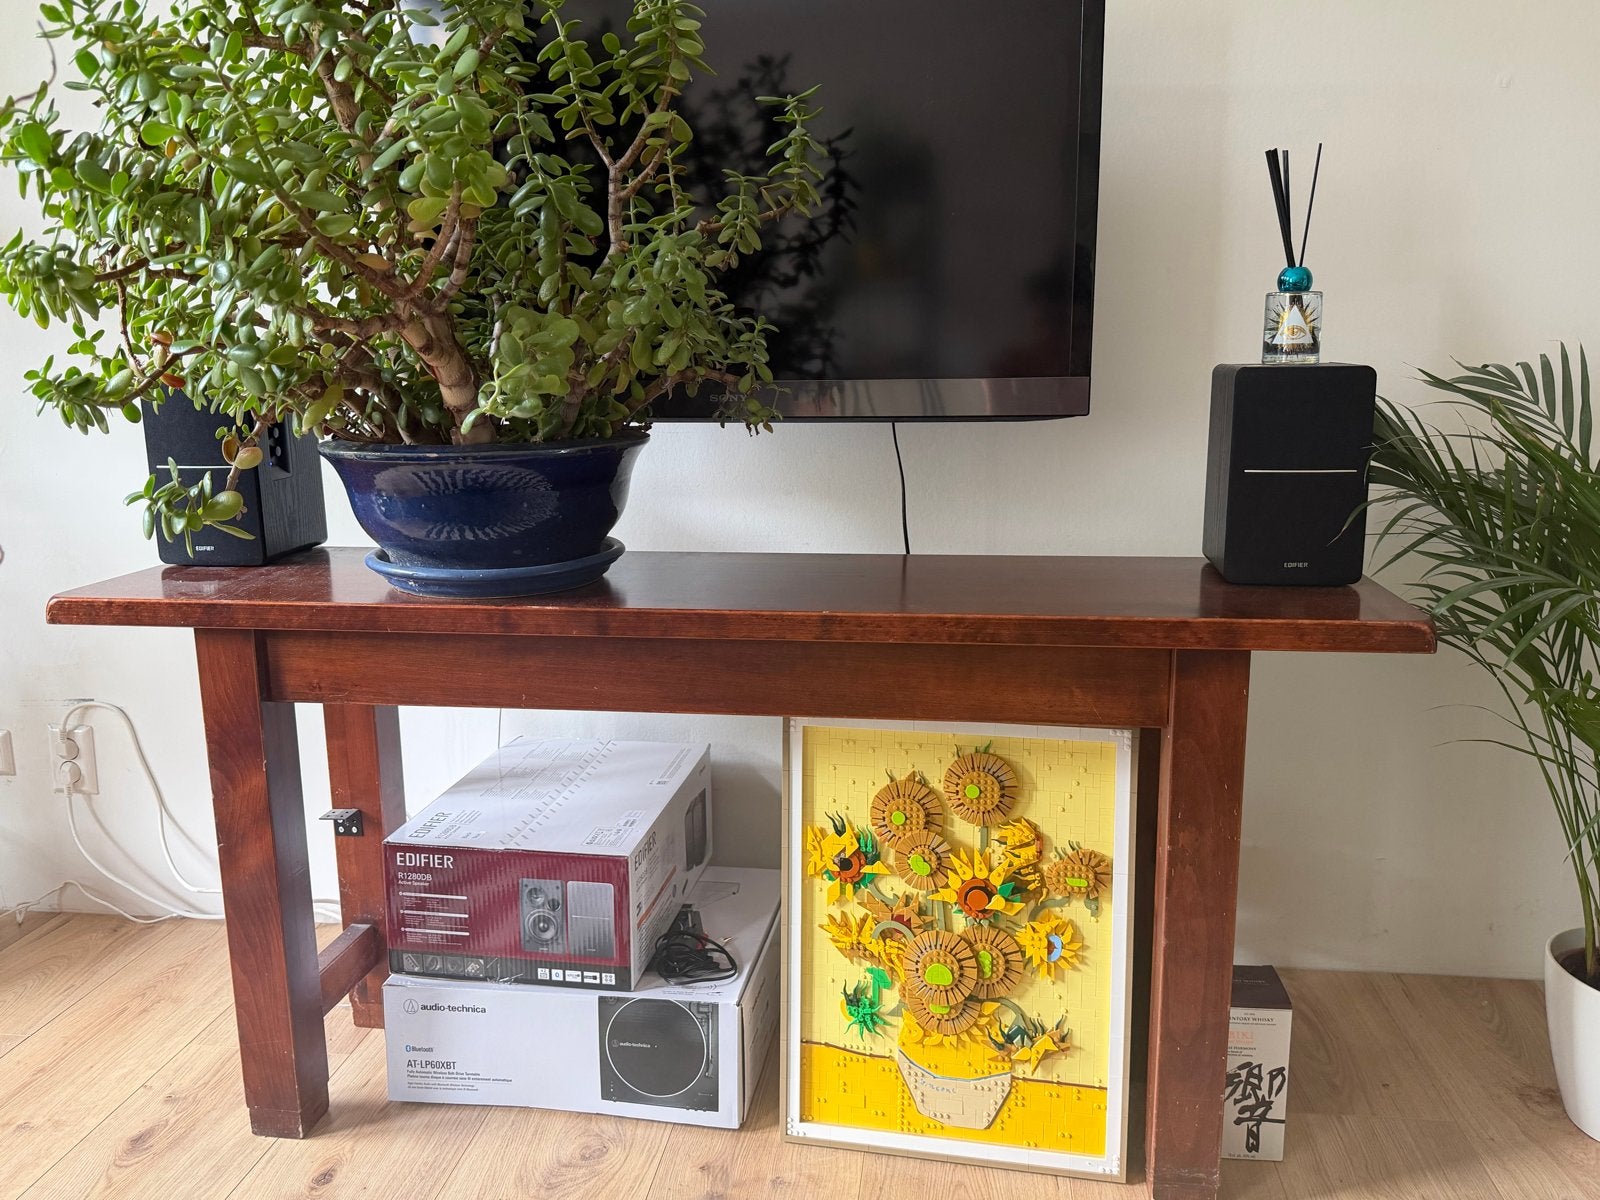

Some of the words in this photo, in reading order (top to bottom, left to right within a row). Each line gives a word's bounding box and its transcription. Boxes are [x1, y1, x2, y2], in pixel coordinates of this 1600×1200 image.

[709, 394, 746, 402] SONY
[408, 811, 452, 838] EDIFIER
[396, 852, 454, 869] EDIFIER
[398, 872, 432, 881] R1280DB
[420, 1003, 487, 1013] audio-technica
[407, 1059, 457, 1070] AT-LP60XBT
